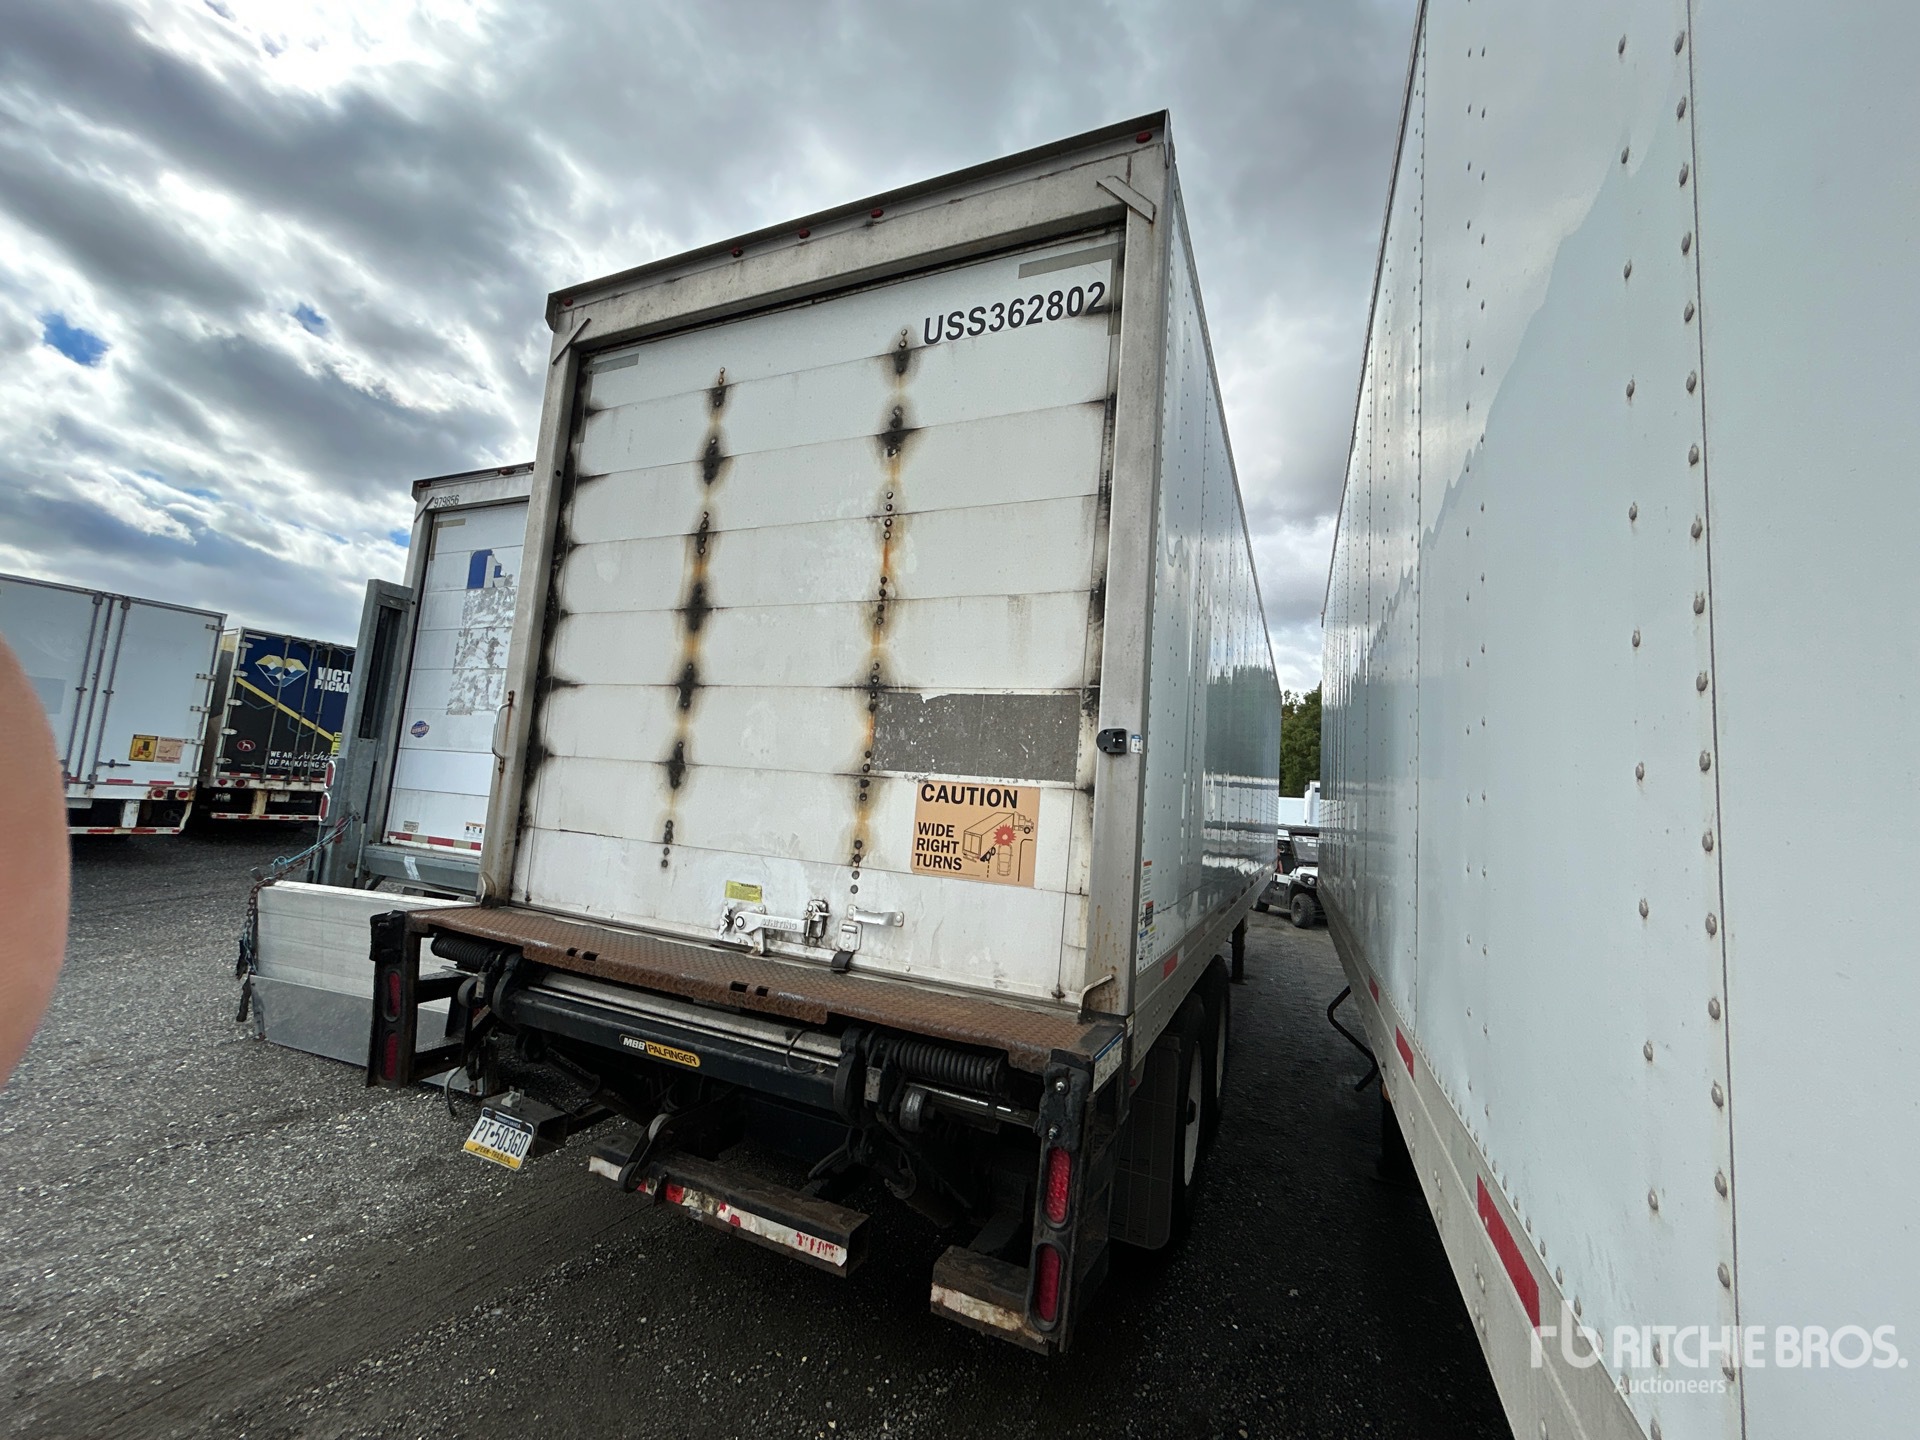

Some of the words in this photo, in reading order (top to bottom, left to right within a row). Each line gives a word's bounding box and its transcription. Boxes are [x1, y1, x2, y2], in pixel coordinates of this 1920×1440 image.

[924, 281, 1105, 345] USS362802
[318, 666, 352, 684] VICT
[268, 758, 279, 766] OF
[270, 750, 281, 758] WE
[282, 751, 296, 759] AR
[921, 783, 1018, 809] CAUTION
[918, 821, 955, 838] WIDE
[916, 837, 959, 855] RIGHT
[914, 853, 962, 871] TURNS
[623, 1037, 646, 1051] MBB
[647, 1043, 697, 1066] PALFINGER
